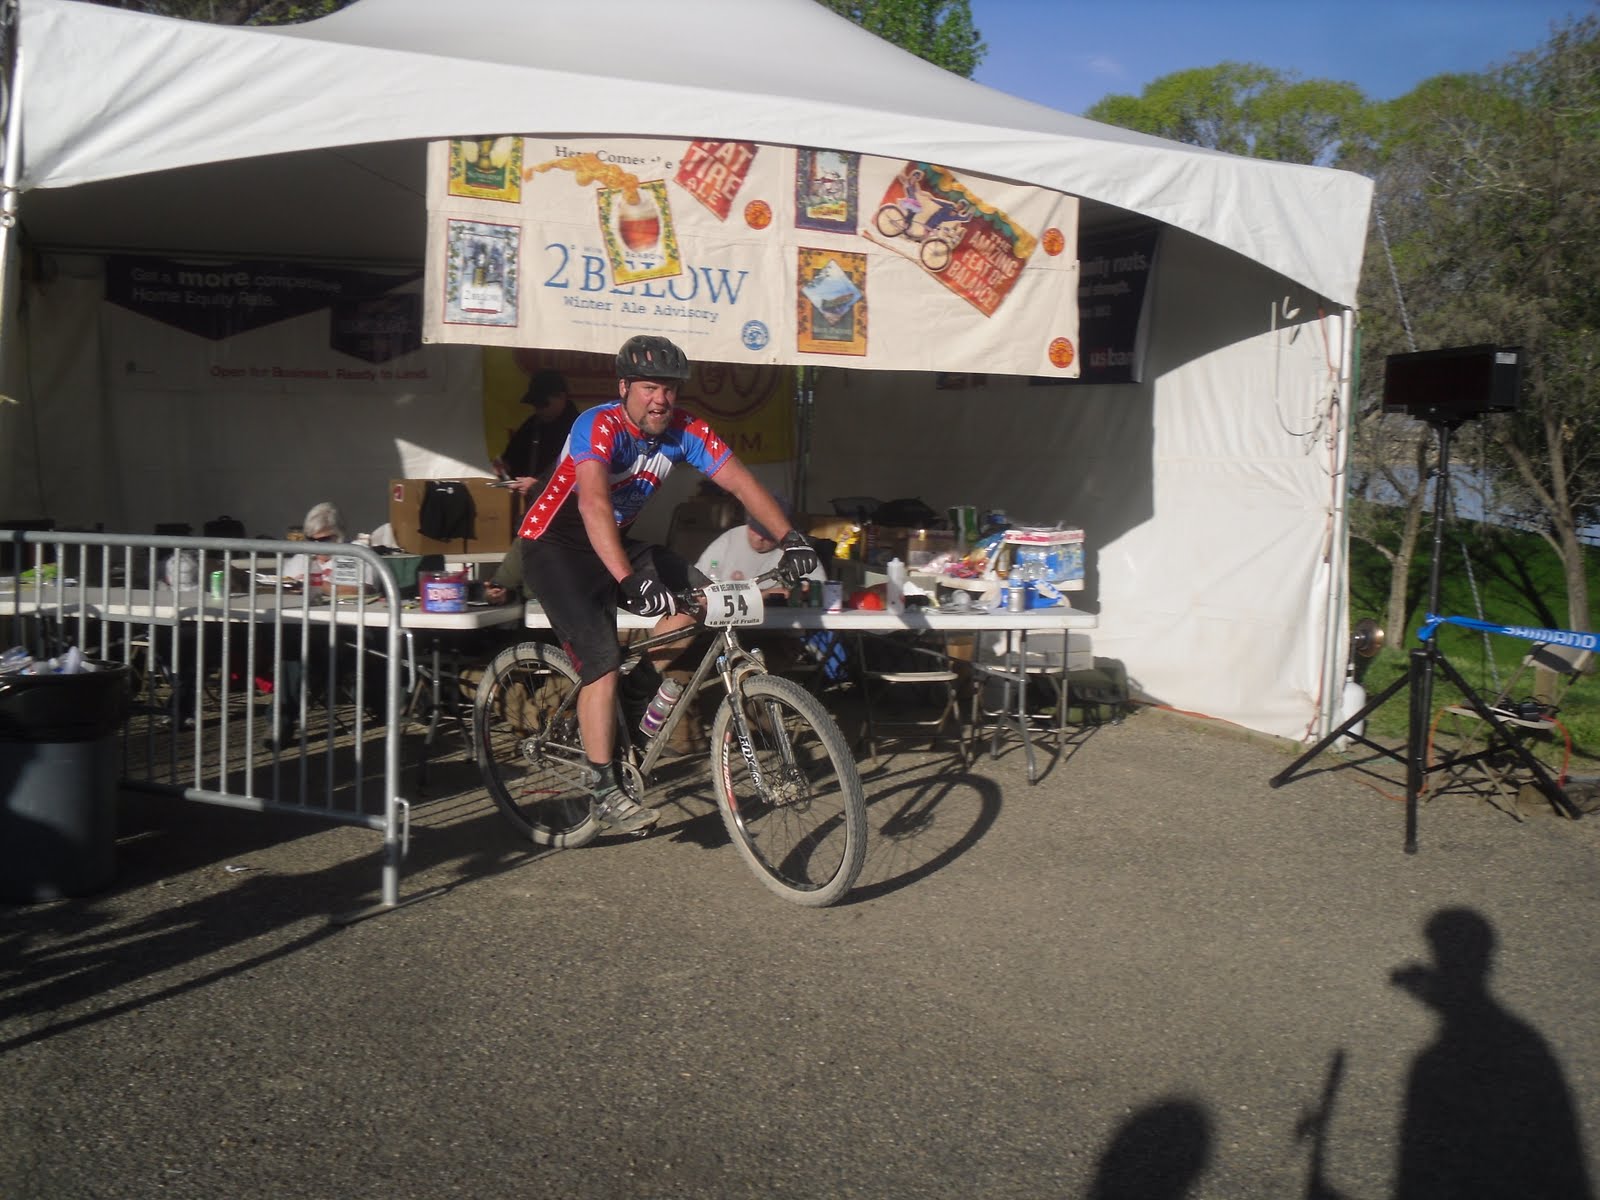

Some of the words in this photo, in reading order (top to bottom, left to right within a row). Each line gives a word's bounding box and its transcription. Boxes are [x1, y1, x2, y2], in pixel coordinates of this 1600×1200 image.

[595, 149, 645, 165] Comes
[685, 145, 742, 200] TIRE
[687, 177, 722, 206] ALE
[968, 231, 1019, 277] AMAZING
[177, 270, 250, 288] more
[961, 249, 992, 277] FEAT
[987, 269, 1008, 289] OF
[132, 287, 182, 304] Home
[186, 290, 236, 308] Equity
[563, 295, 612, 311] Winter
[621, 301, 647, 314] Ale
[653, 304, 720, 323] Advisory
[209, 365, 246, 379] Open
[723, 594, 748, 618] 54
[1501, 626, 1597, 649] SHIMANO
[738, 735, 757, 769] FOX
